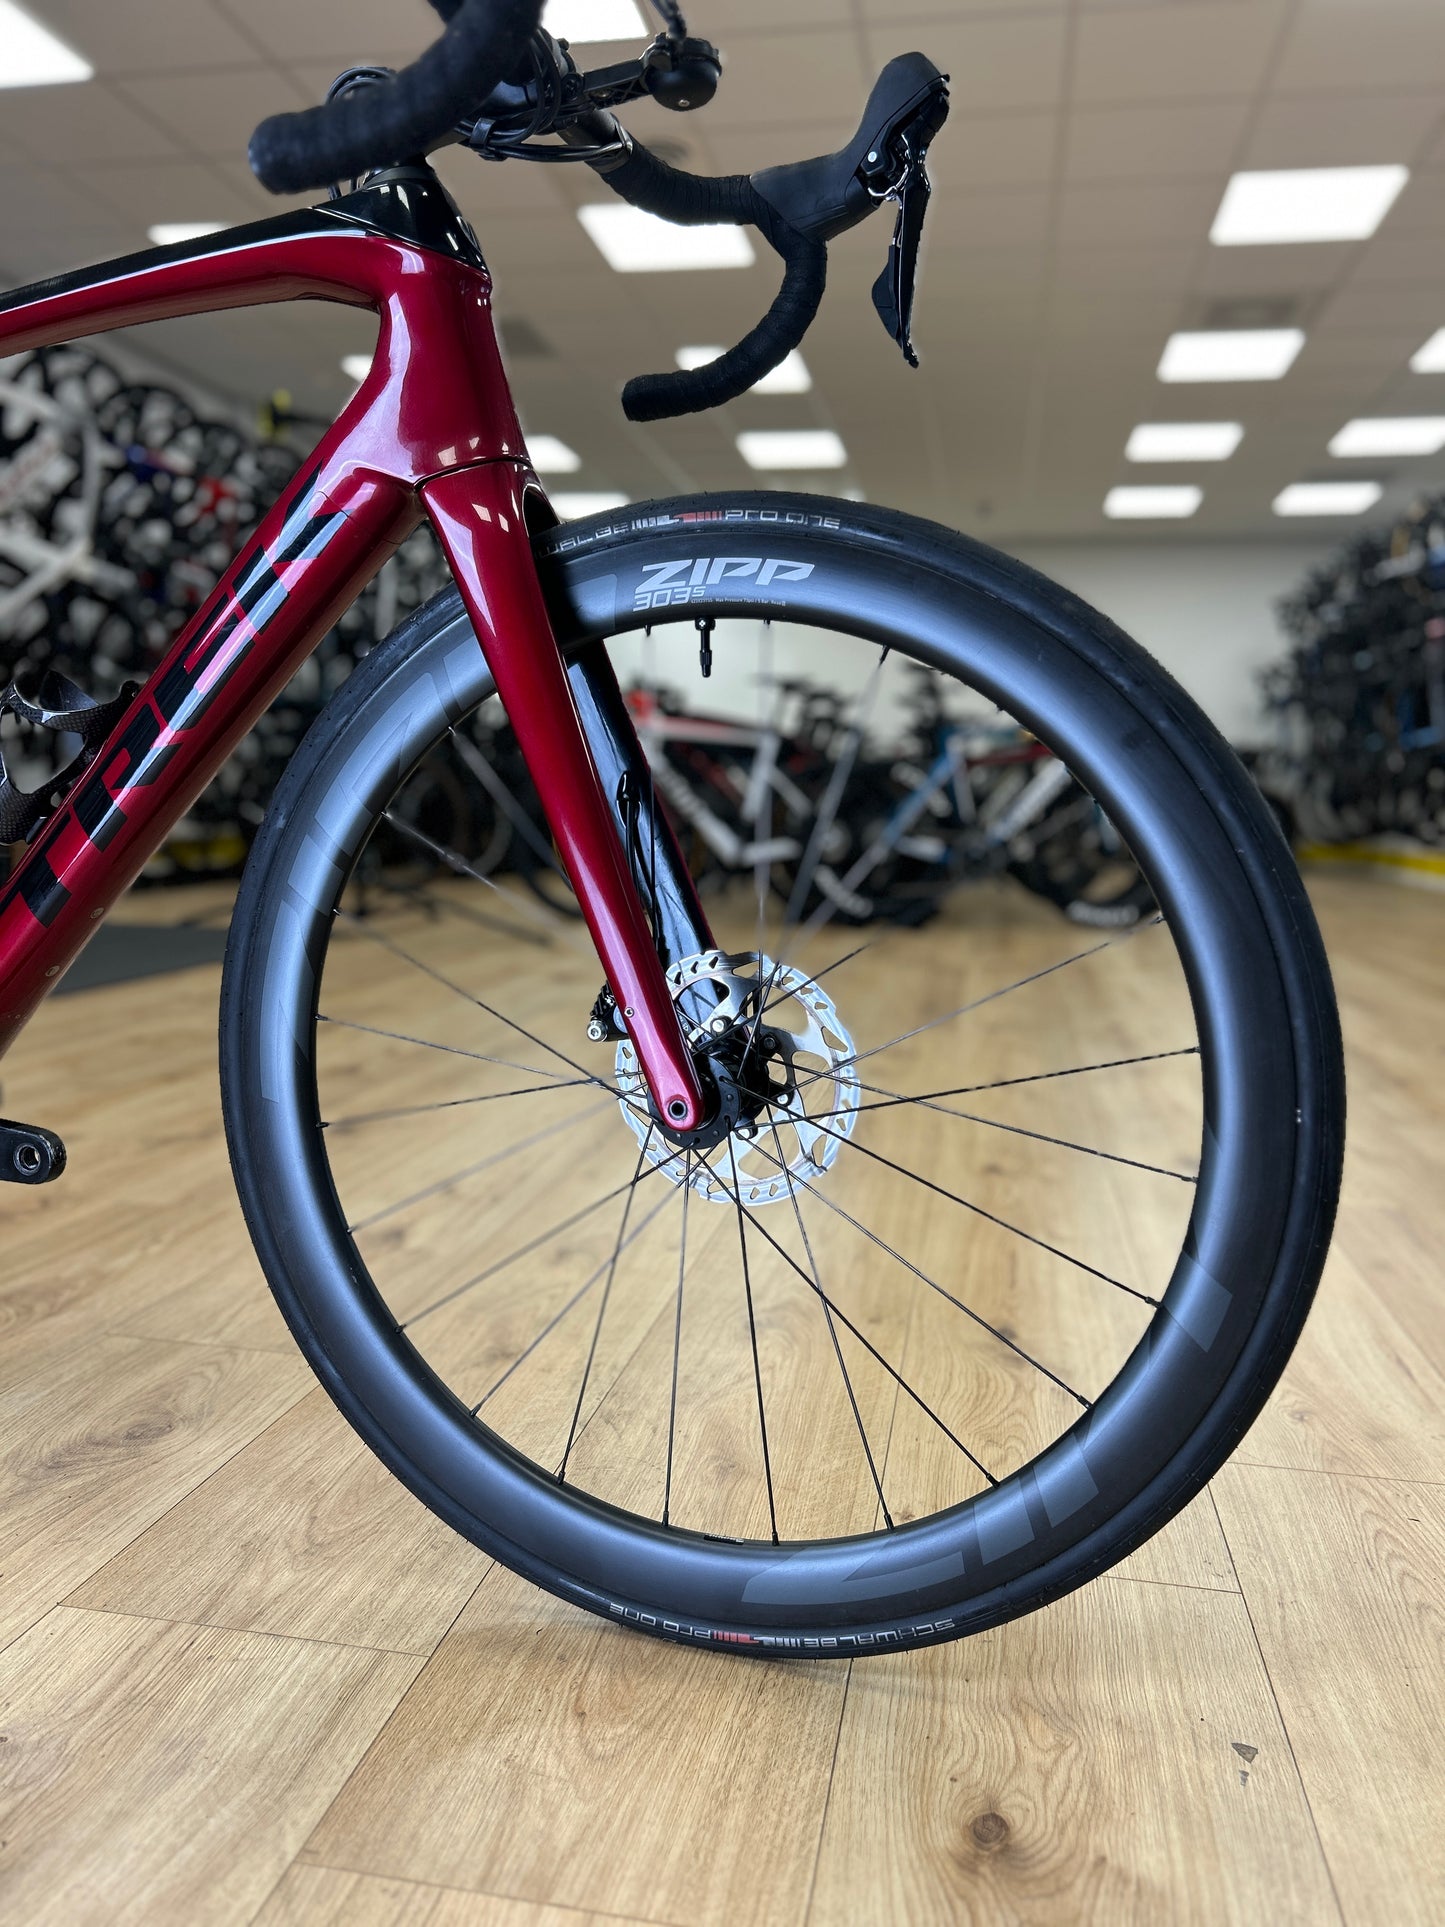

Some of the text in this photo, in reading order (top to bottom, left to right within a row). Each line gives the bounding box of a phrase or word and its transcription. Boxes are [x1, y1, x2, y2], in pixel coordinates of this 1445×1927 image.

[536, 522, 630, 556] WALBE
[635, 557, 815, 594] ZIPP
[0, 458, 353, 928] TREK
[803, 1618, 955, 1648] SCHWALBE
